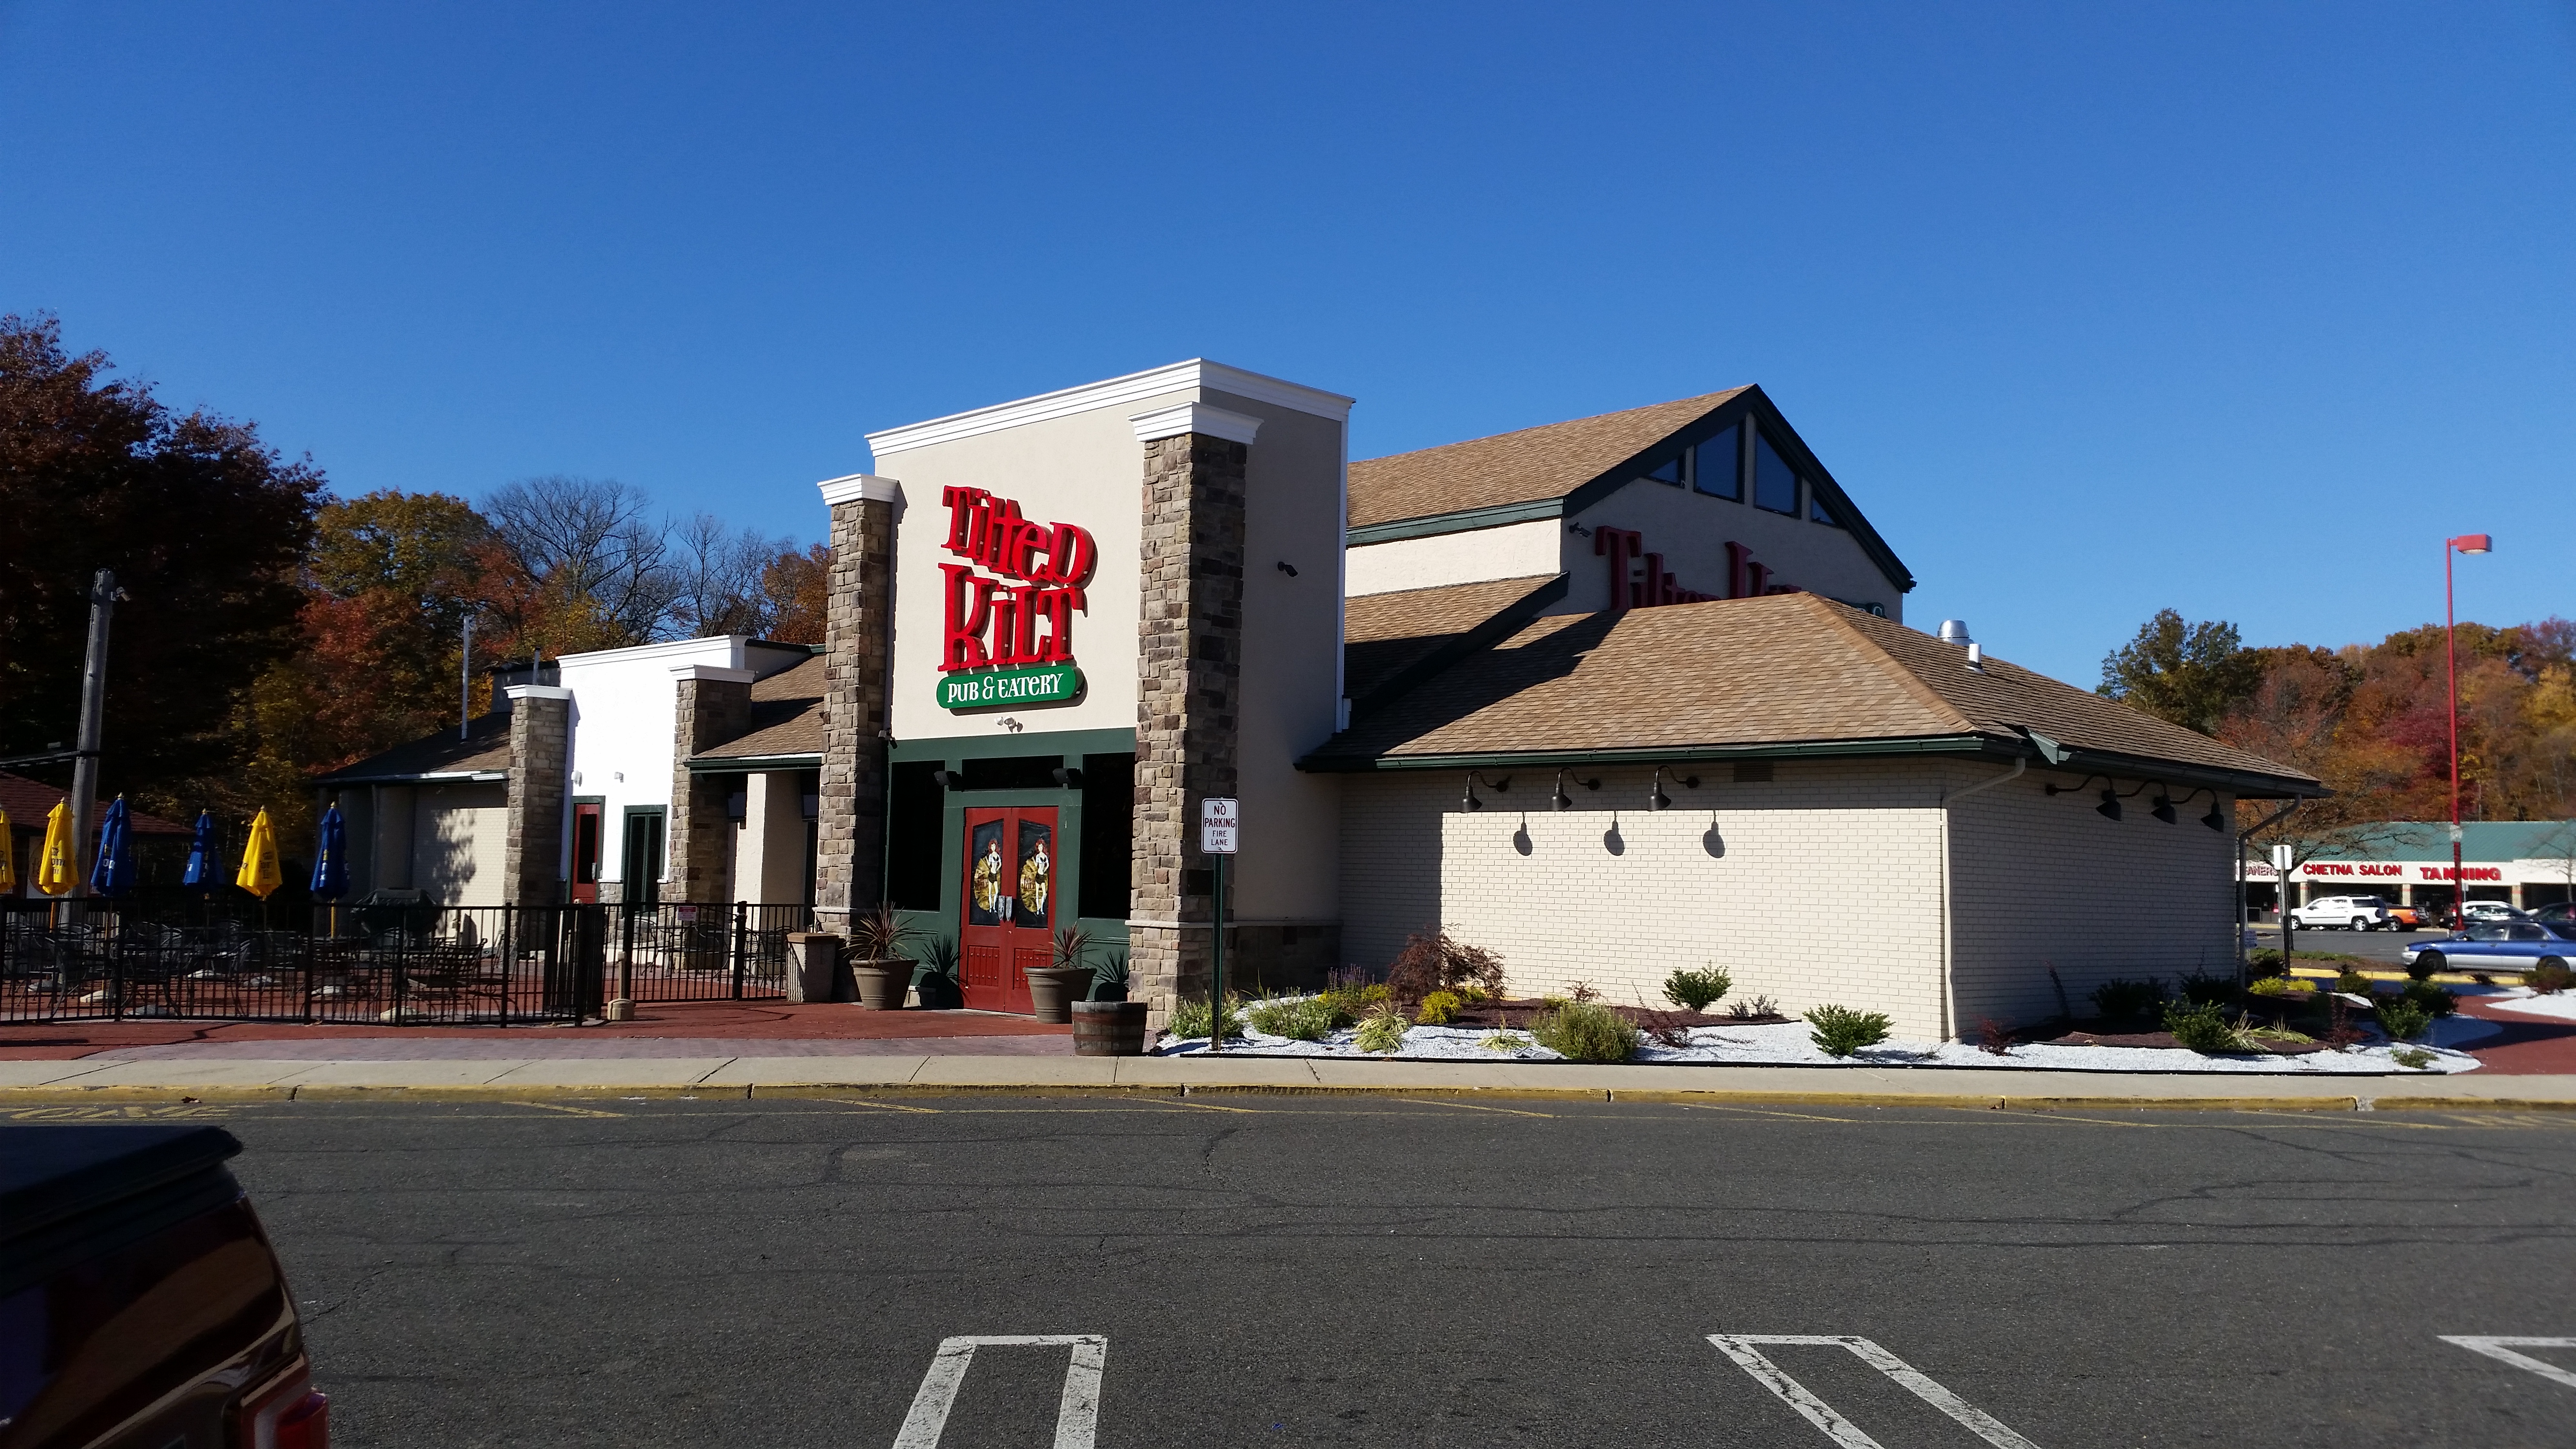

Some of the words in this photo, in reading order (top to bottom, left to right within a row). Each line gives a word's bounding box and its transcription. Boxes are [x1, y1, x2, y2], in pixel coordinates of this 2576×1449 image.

[947, 682, 979, 703] PUB
[982, 676, 994, 700] &
[1214, 805, 1226, 815] NO
[1205, 818, 1235, 828] PARKING
[2245, 866, 2278, 876] ANERS
[2302, 863, 2355, 876] CHETNA
[2359, 864, 2402, 876] SALON
[2419, 867, 2502, 881] TANNING
